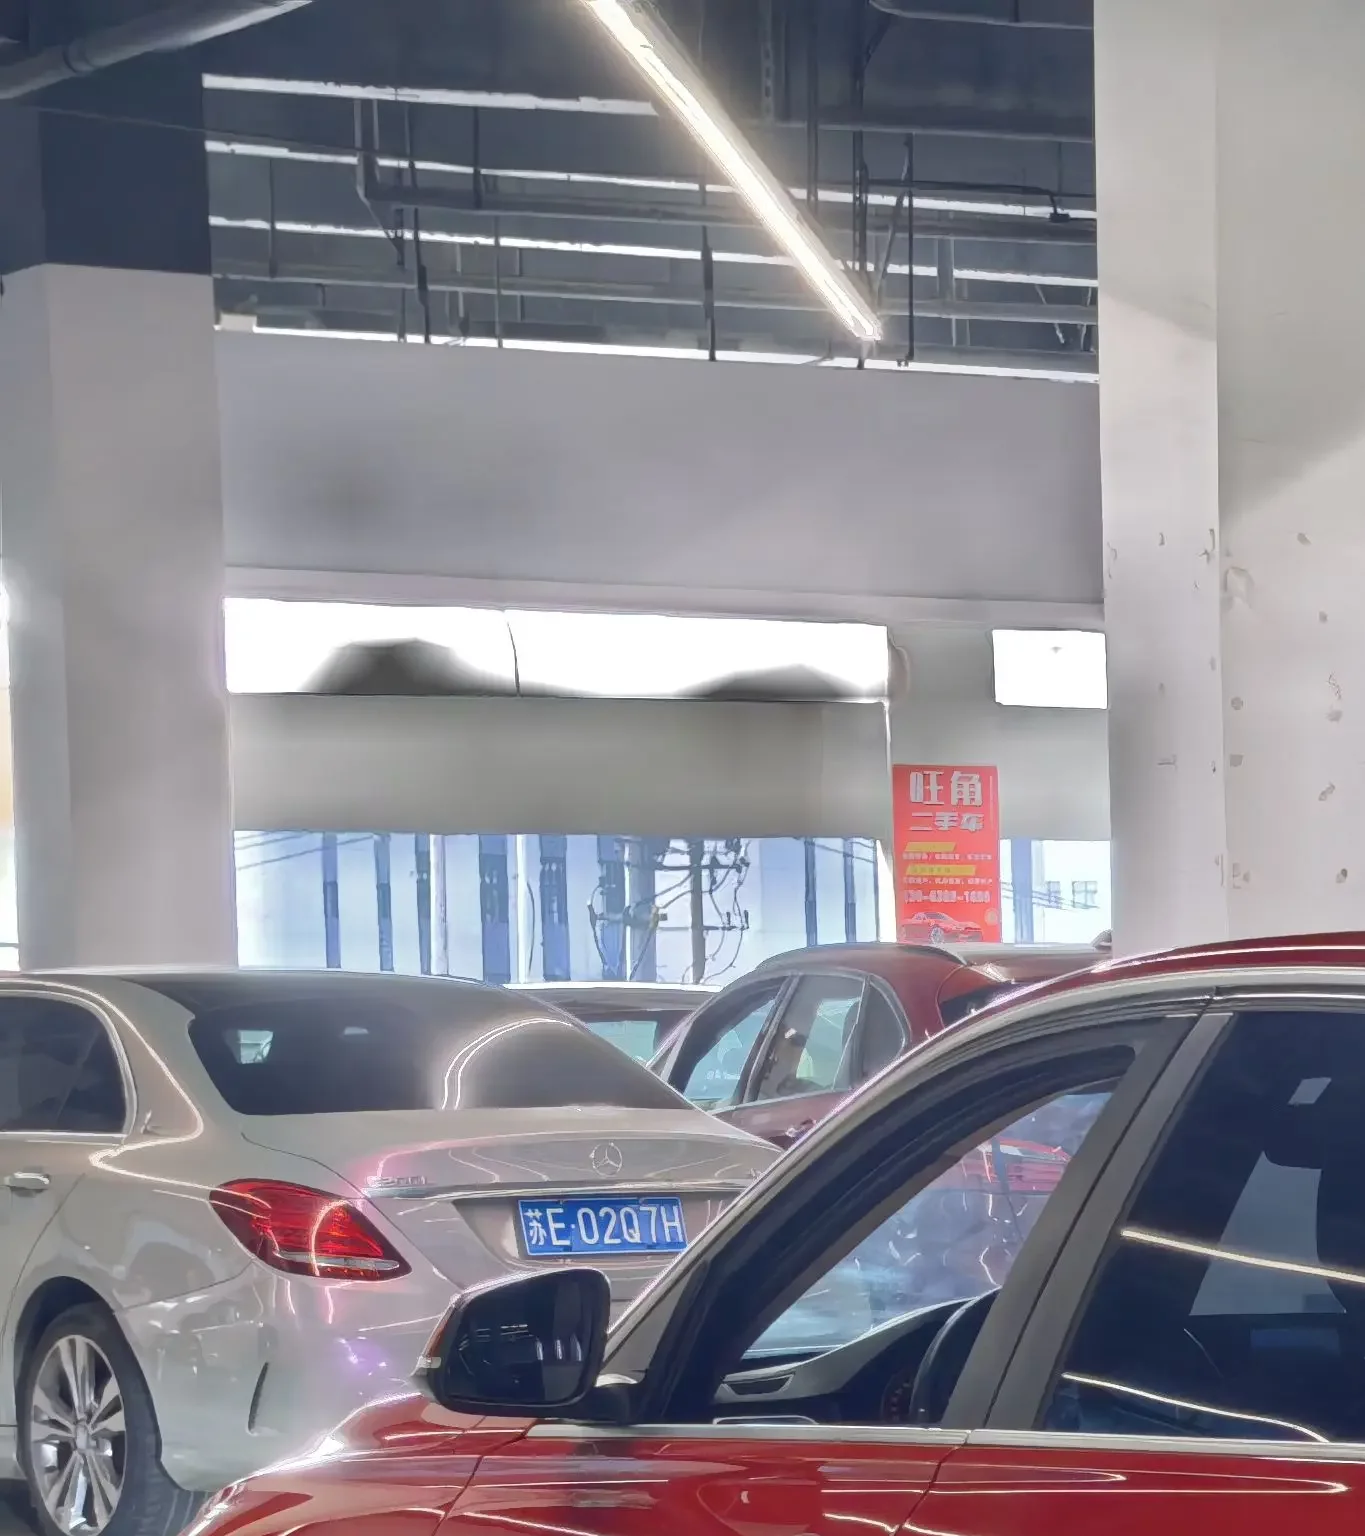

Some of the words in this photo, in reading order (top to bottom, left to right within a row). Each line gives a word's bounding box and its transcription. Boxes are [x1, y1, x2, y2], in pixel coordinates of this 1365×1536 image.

[909, 770, 983, 807] 旺角
[909, 812, 984, 832] 二手车
